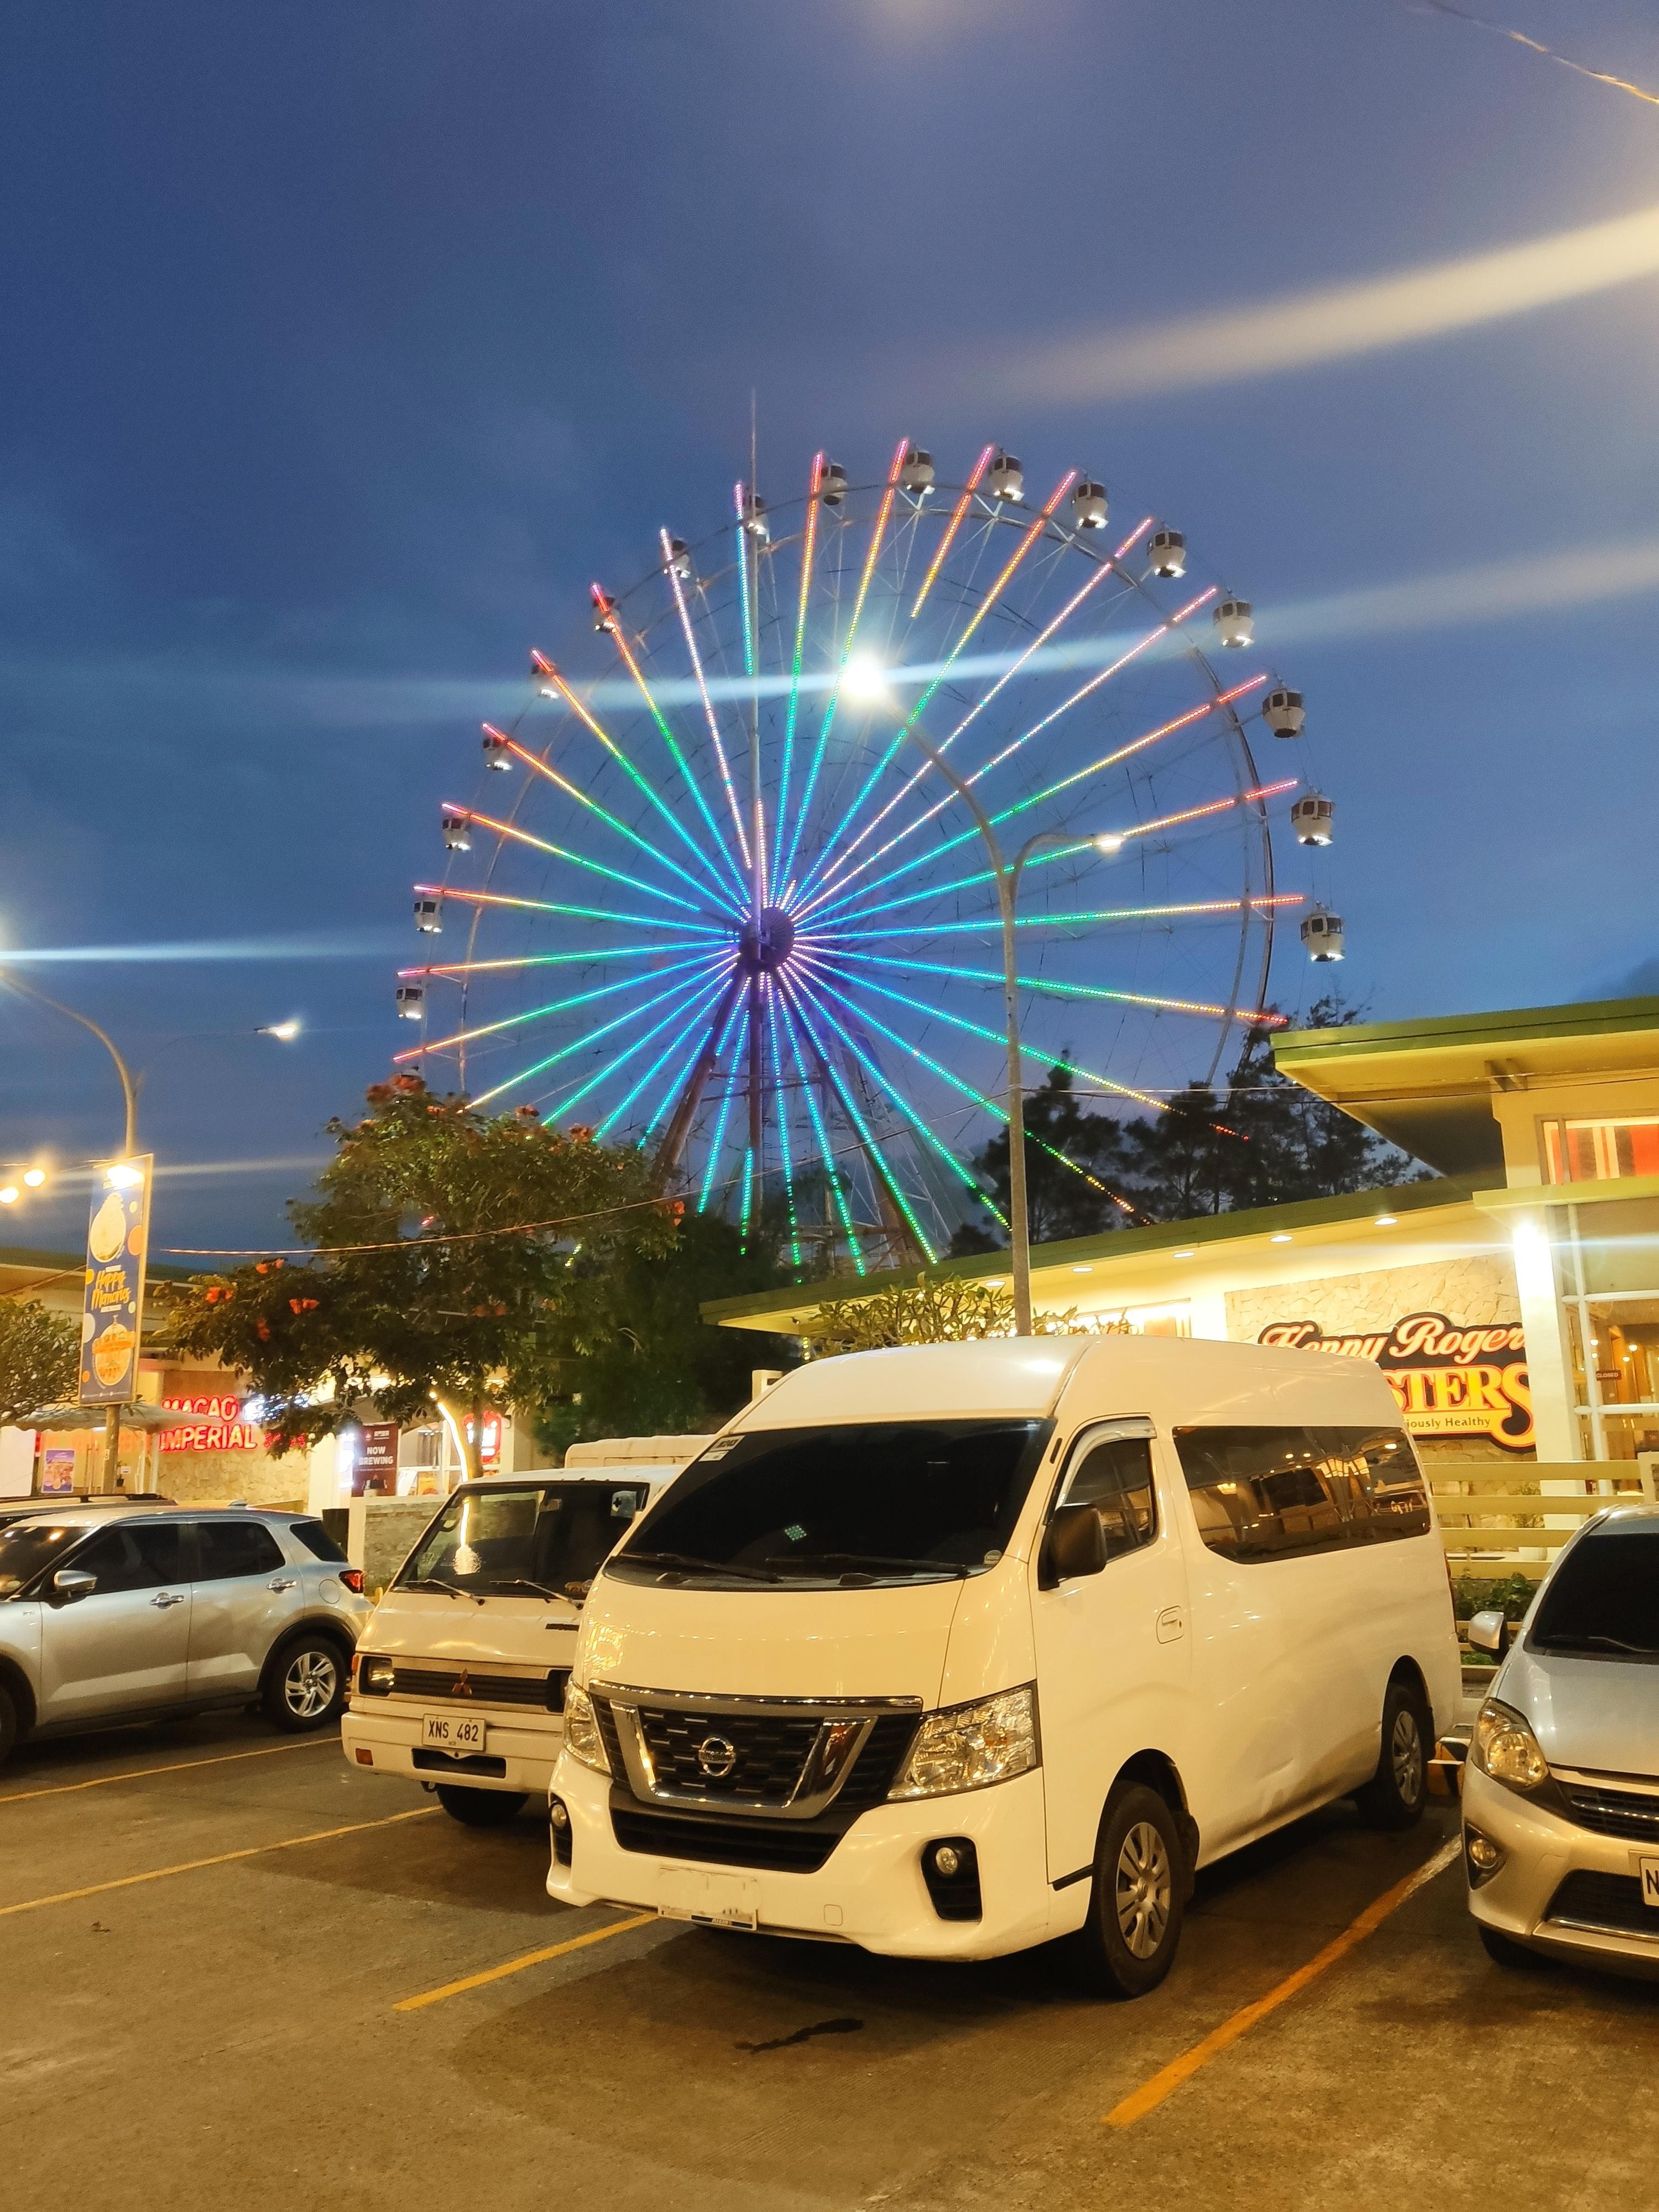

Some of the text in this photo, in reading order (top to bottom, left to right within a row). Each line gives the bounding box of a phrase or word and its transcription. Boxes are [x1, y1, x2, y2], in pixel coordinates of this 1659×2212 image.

[96, 1270, 126, 1292] Happy
[1445, 1416, 1490, 1428] Healthy
[159, 1424, 258, 1451] IMPERIAL
[367, 1446, 386, 1455] NOW
[358, 1455, 394, 1465] BREWING
[428, 1720, 478, 1742] XNS 482
